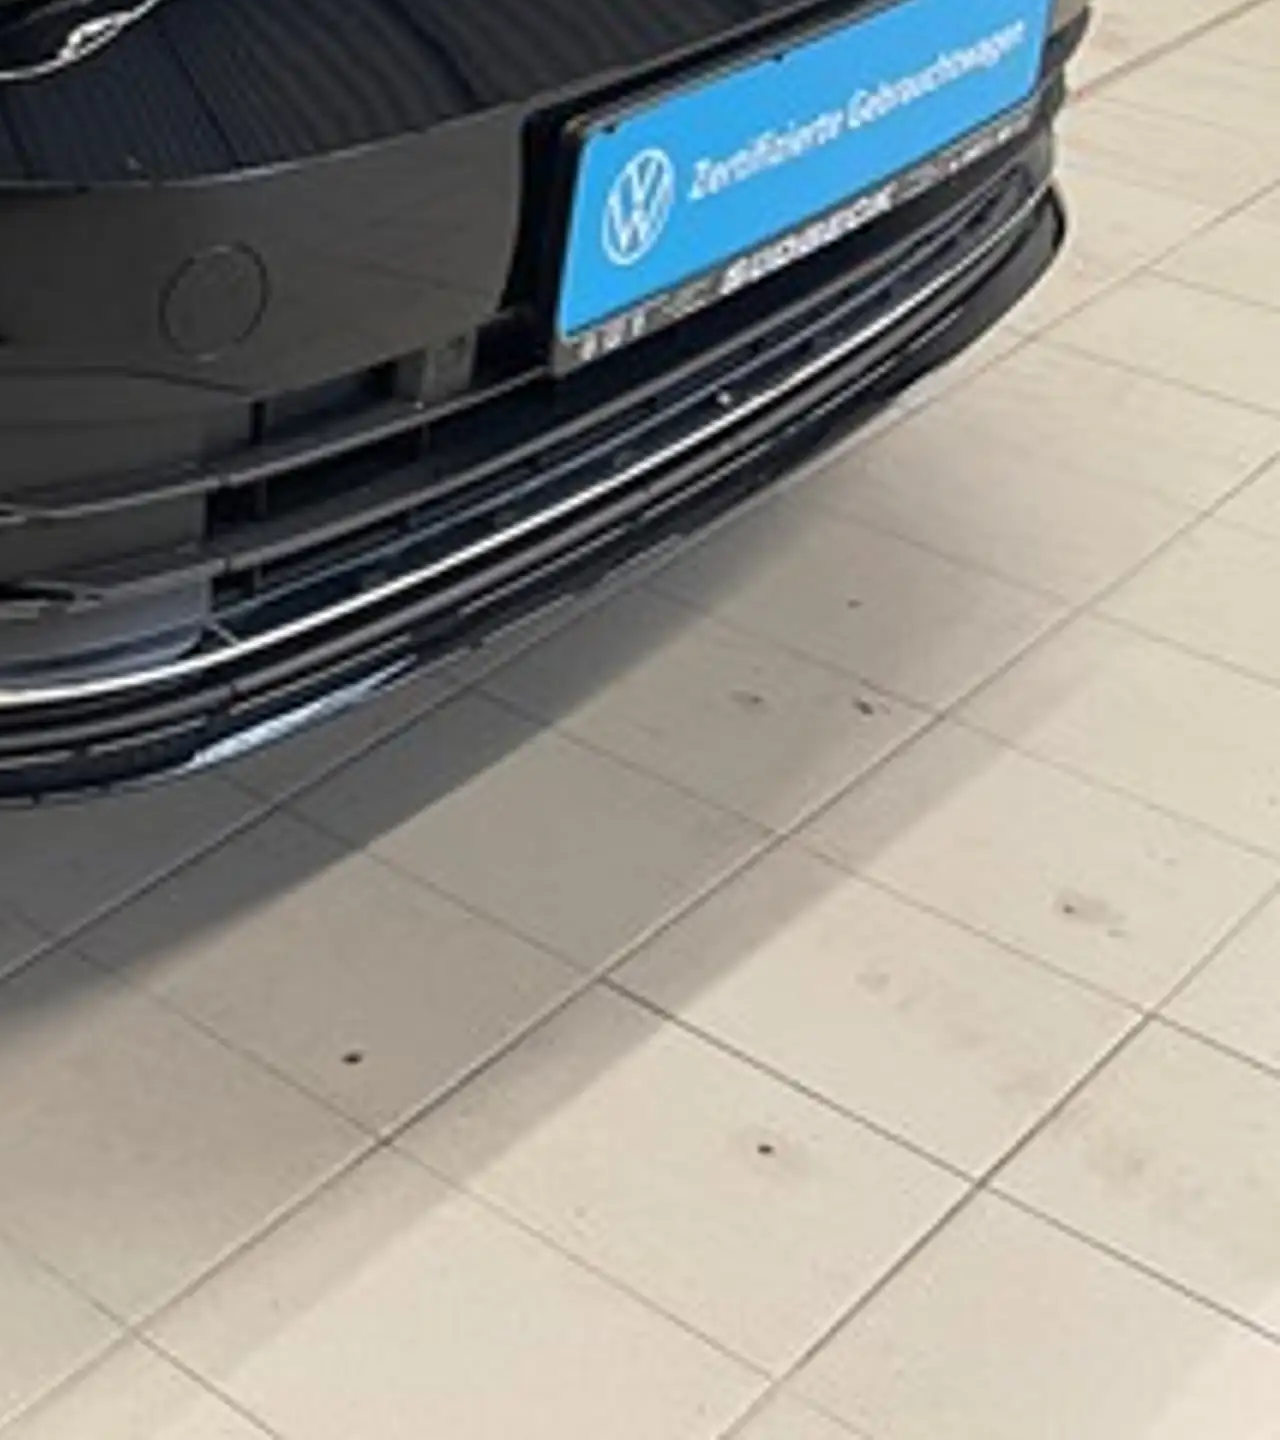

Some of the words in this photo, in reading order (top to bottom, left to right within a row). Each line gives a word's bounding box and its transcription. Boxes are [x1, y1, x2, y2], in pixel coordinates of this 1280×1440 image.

[688, 108, 843, 200] Zertifizierte
[848, 20, 1026, 129] Gebrauchtwagen
[602, 148, 676, 265] VW
